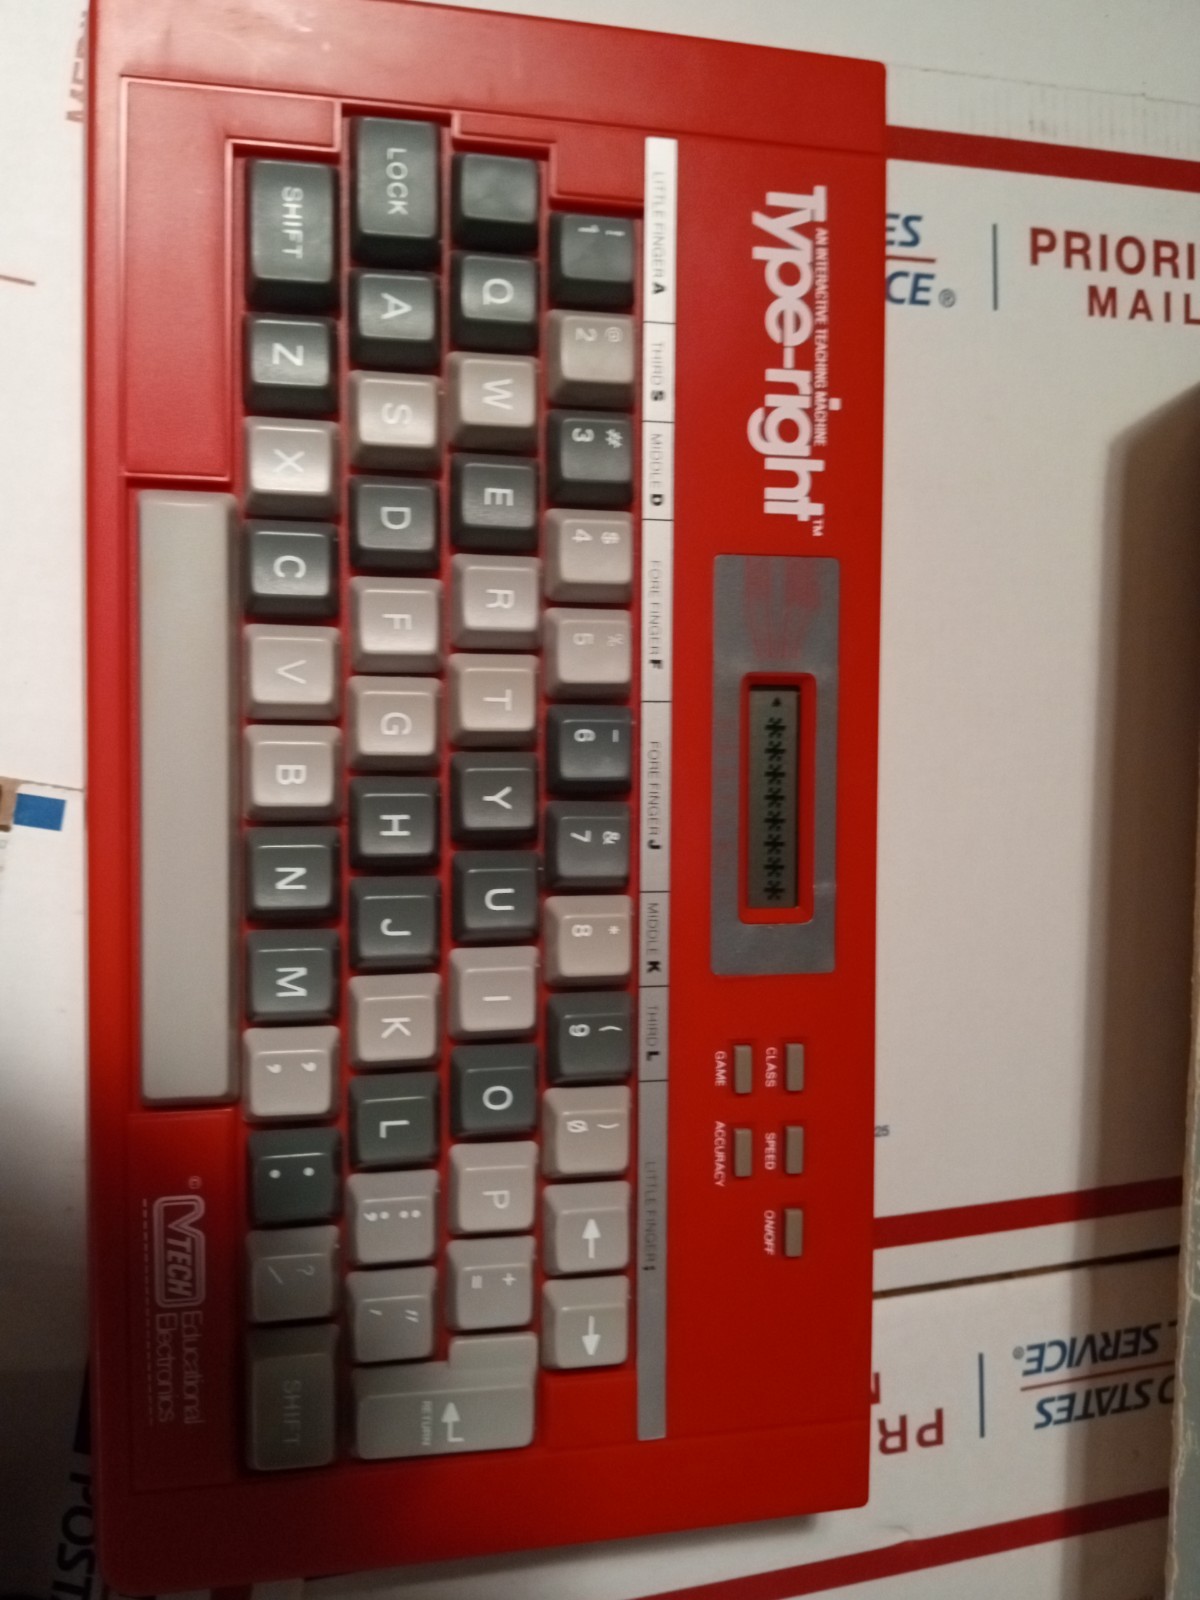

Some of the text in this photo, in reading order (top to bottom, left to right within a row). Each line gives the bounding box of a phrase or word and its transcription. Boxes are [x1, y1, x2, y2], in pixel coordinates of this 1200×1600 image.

[386, 147, 408, 216] LOCK
[280, 186, 304, 260] SHIFT
[578, 223, 599, 234] 1
[651, 171, 666, 295] LITTLE FINGER A
[482, 278, 514, 305] Q
[381, 292, 412, 320] A
[575, 327, 595, 342] 2
[814, 228, 828, 446] AN INTERACTIVE TEACHING MACHINE
[272, 342, 304, 368] Z
[747, 185, 841, 522] Type-right
[650, 342, 665, 402] THIRD S
[483, 378, 513, 410] W
[382, 402, 412, 425] S
[572, 427, 594, 443] 3
[274, 448, 304, 473] X
[649, 433, 664, 507] MIDDLE D
[484, 487, 513, 507] E
[380, 505, 411, 530] D
[572, 529, 593, 543] 4
[274, 554, 306, 579] C
[486, 588, 514, 609] R
[382, 613, 412, 630] F
[648, 561, 663, 670] FORE FINGER F
[574, 632, 593, 646] 5
[277, 659, 307, 684] V
[484, 689, 512, 711] T
[380, 712, 412, 736] G
[574, 728, 596, 743] 6
[276, 764, 307, 785] B
[483, 786, 512, 809] Y
[647, 741, 661, 850] FORE FINGER J
[380, 814, 411, 837] H
[569, 830, 591, 843] 7
[275, 867, 307, 890] N
[485, 888, 515, 911] U
[380, 918, 411, 937] J
[571, 923, 592, 937] 8
[647, 902, 661, 973] MIDDLE K
[276, 967, 307, 997] M
[381, 1017, 411, 1039] K
[569, 1023, 590, 1037] 9
[646, 1005, 660, 1061] THIRD L
[714, 1050, 727, 1087] GAME
[765, 1046, 777, 1088] CLASS
[483, 1085, 513, 1111] O
[379, 1120, 410, 1138] L
[714, 1121, 726, 1187] ACCURACY
[764, 1132, 776, 1170] SPEED
[644, 1161, 658, 1207] LITTLE
[483, 1190, 510, 1209] P
[763, 1210, 775, 1255] ON/OFF
[161, 1199, 203, 1301] VTECH
[155, 1313, 178, 1422] Electronics
[182, 1311, 202, 1424] Educational
[282, 1379, 302, 1445] SHIFT
[1034, 1378, 1153, 1429] STATES
[420, 1400, 432, 1446] RETURN
[878, 1408, 943, 1455] PR
